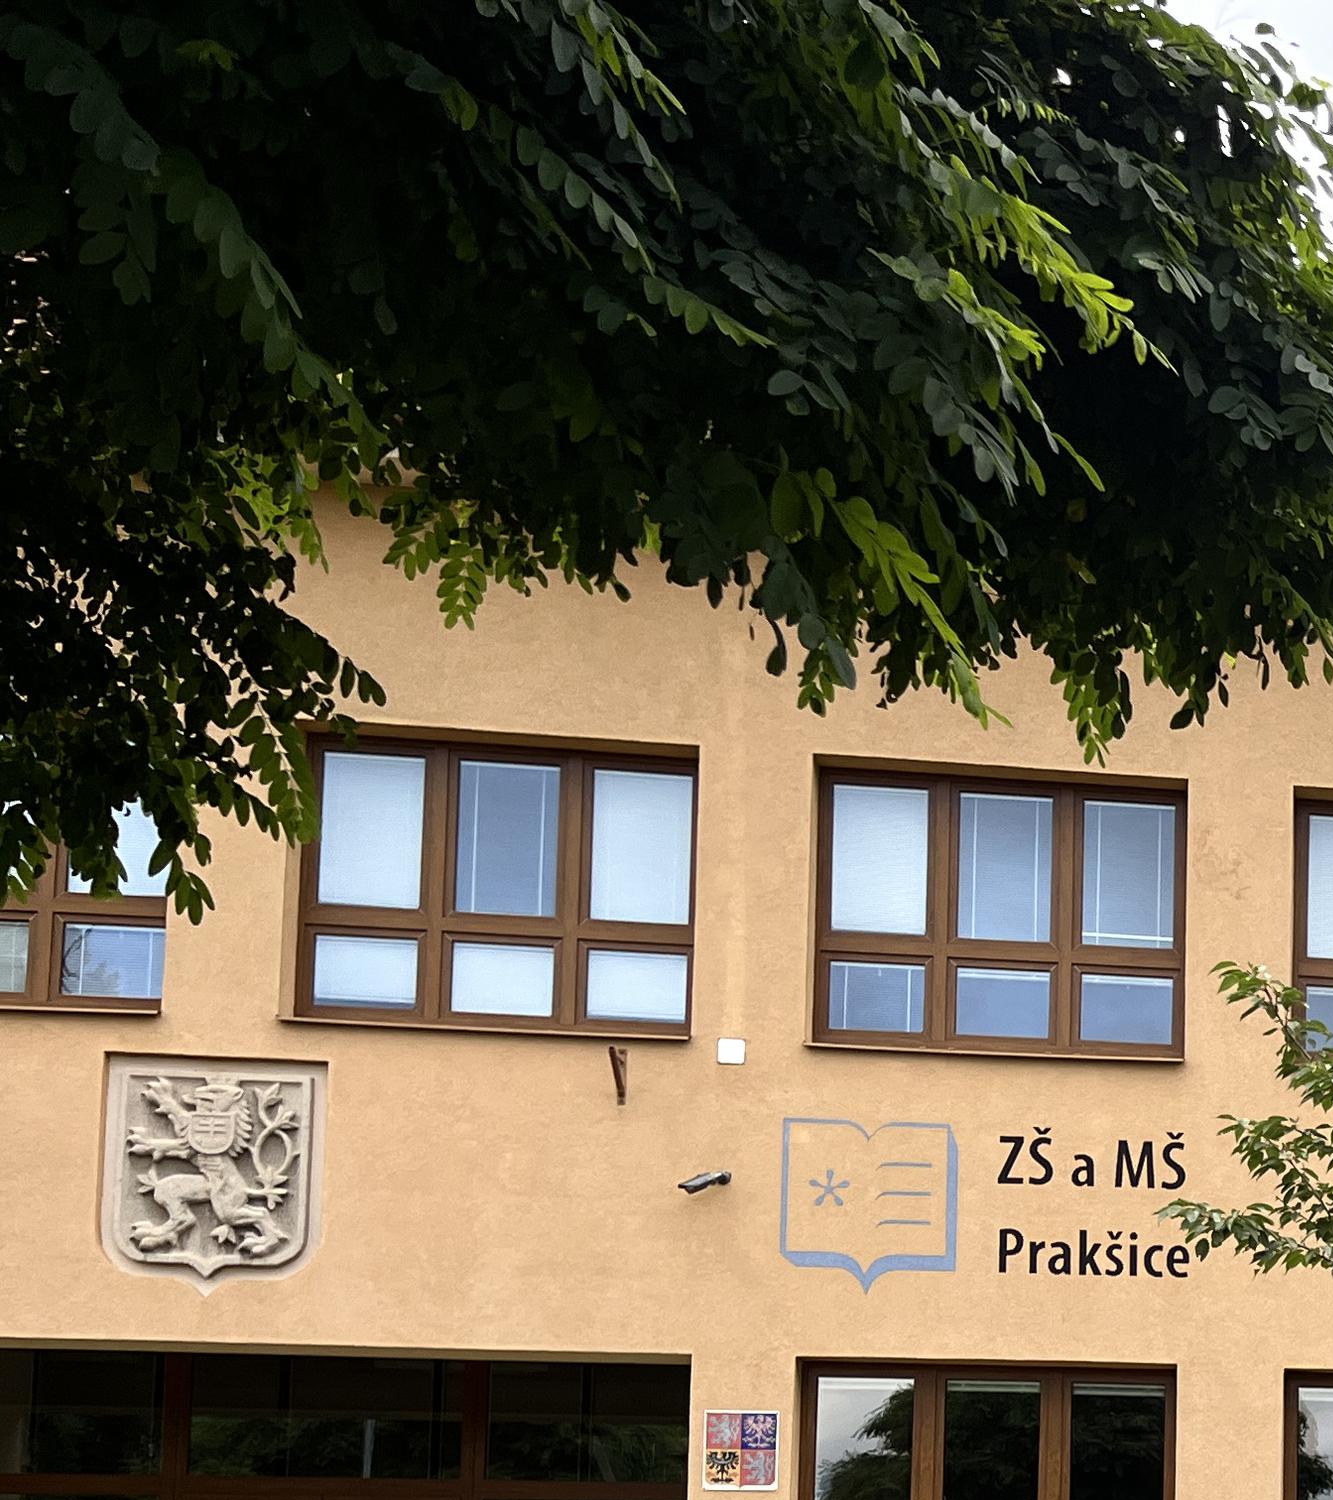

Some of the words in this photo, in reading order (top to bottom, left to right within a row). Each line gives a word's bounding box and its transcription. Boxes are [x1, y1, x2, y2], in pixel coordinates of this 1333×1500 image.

[997, 1126, 1055, 1186] ZŠ
[1071, 1154, 1096, 1188] a
[1113, 1131, 1187, 1191] MŠ
[997, 1227, 1191, 1279] Prakšice
